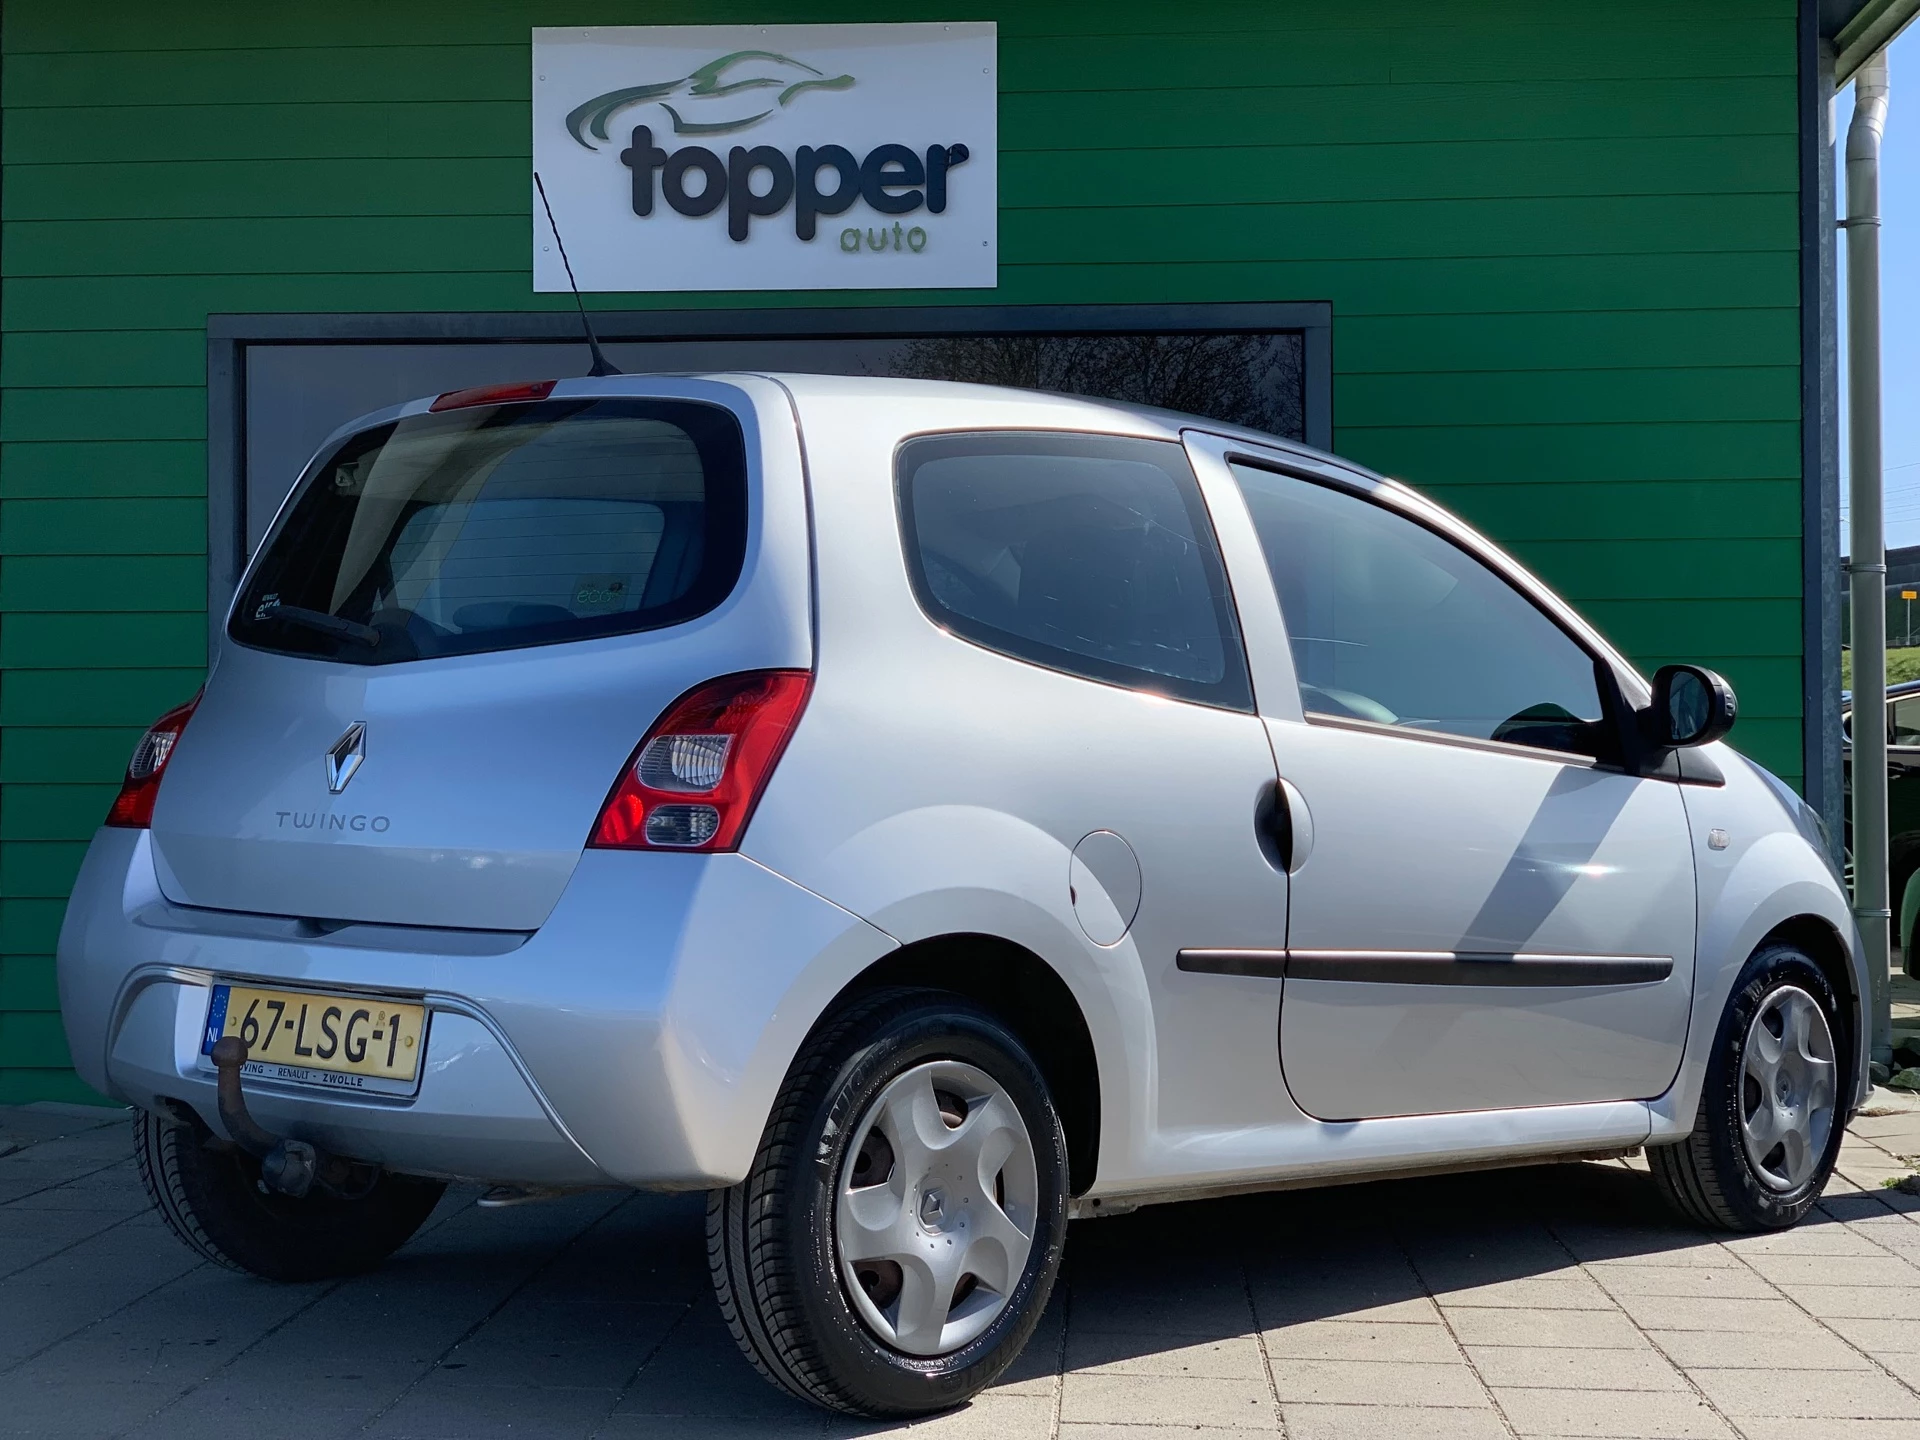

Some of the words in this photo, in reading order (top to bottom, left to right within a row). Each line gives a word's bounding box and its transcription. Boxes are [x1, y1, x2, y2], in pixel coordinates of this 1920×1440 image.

[620, 125, 969, 242] topper
[840, 221, 927, 253] auto
[276, 811, 390, 832] TWINGO
[206, 1026, 219, 1043] NL
[240, 998, 401, 1067] 67-LSG-1
[277, 1067, 310, 1080] RENAULT
[323, 1073, 364, 1087] ZWOLLE
